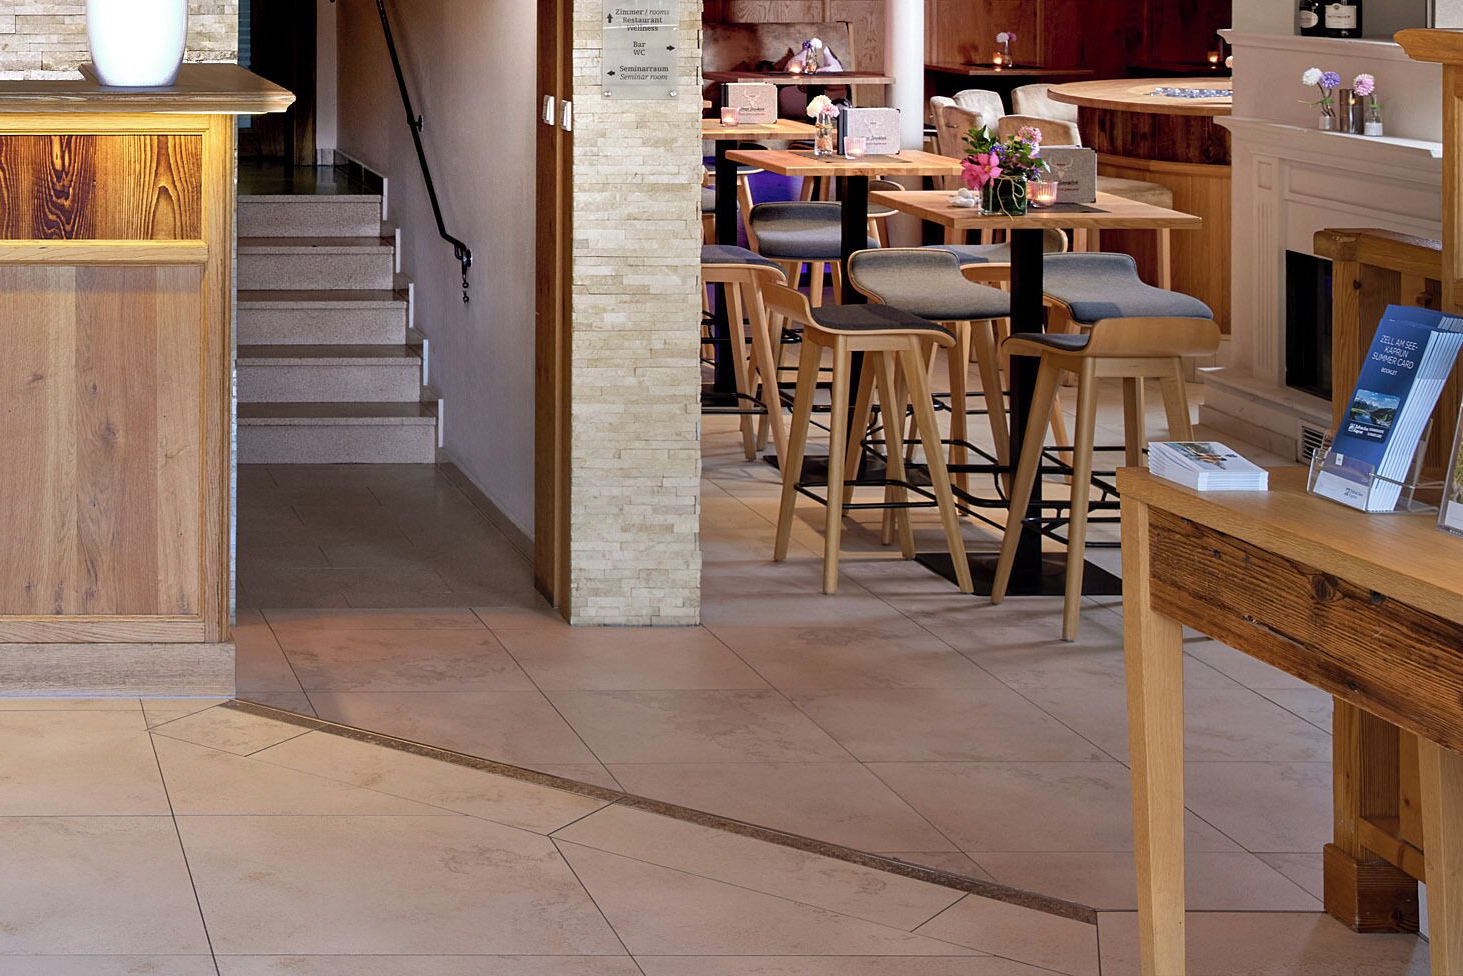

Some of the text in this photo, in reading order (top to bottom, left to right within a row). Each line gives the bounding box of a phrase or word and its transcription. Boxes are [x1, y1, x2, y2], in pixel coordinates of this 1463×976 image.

[615, 8, 644, 16] Zimmer
[626, 24, 659, 32] Wellness
[619, 65, 669, 73] Seminarraum
[619, 73, 649, 81] Seminar
[1380, 334, 1418, 351] ZELL AM SEE-
[1384, 345, 1409, 358] KAPRUN
[1371, 351, 1414, 370] SUMMER CARD
